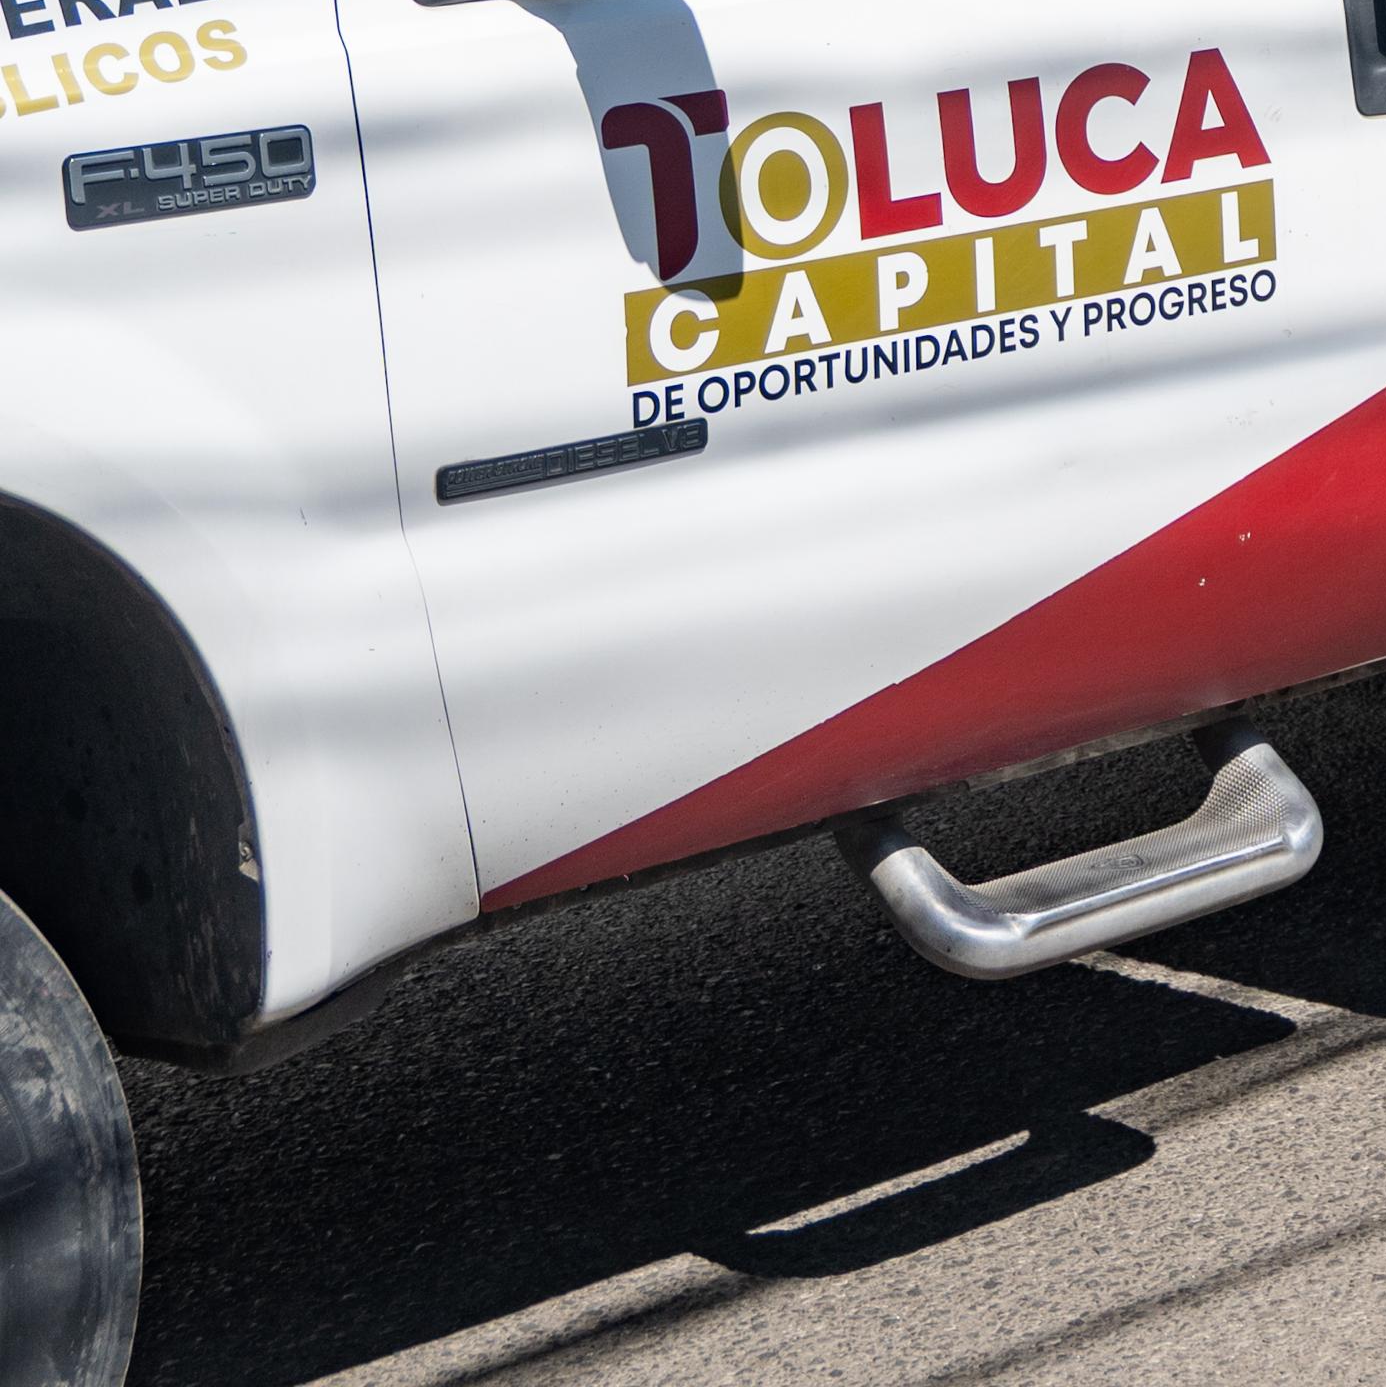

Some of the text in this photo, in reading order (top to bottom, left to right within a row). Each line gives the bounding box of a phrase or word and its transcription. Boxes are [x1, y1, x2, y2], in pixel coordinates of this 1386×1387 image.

[0, 19, 248, 119] LICOS
[69, 127, 314, 205] F-450
[96, 174, 313, 220] XL SUPER DUTY
[601, 47, 1272, 282] TOLUCA
[648, 190, 1261, 374] CAPITAL
[632, 268, 1278, 429] DE OPORTUNIDADES Y PROGRESO
[546, 433, 660, 477] DIESEL
[662, 421, 701, 452] V8
